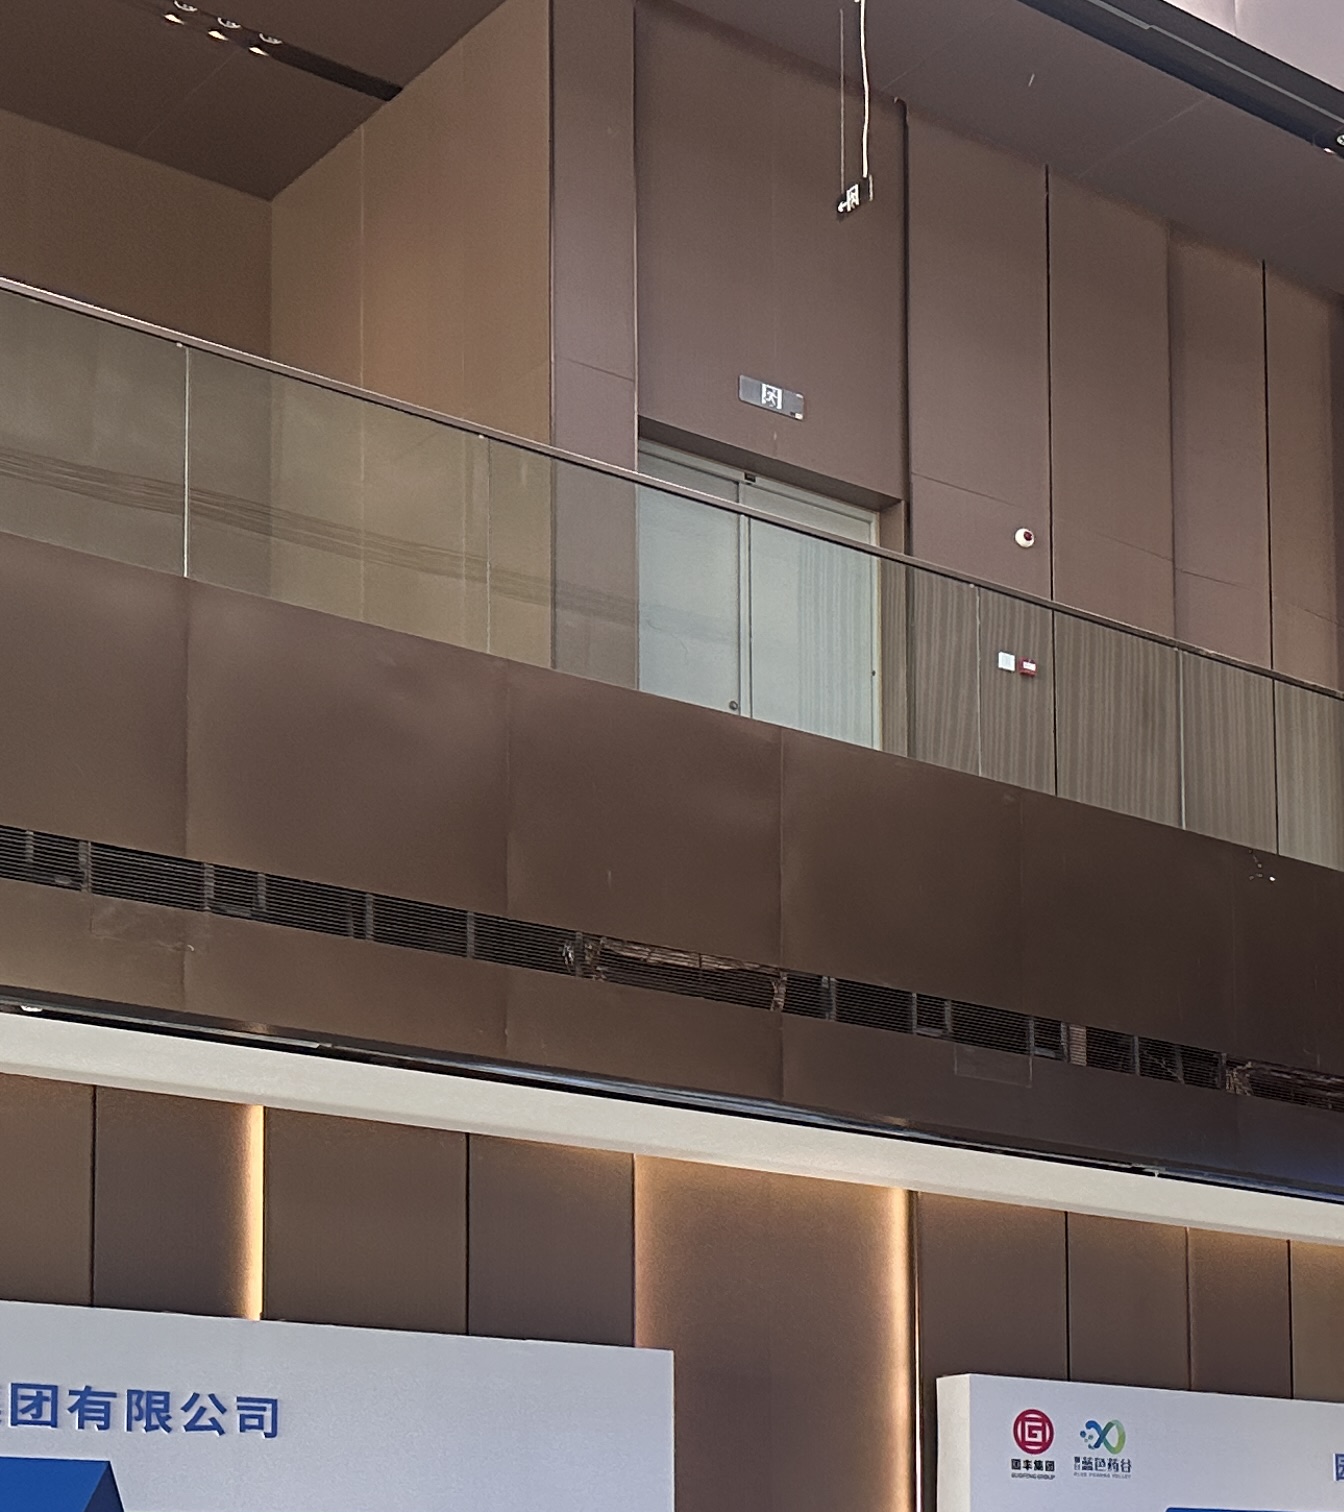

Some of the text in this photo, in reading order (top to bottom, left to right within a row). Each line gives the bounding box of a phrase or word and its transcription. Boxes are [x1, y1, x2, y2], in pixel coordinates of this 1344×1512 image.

[0, 1382, 279, 1438] 团有限公司
